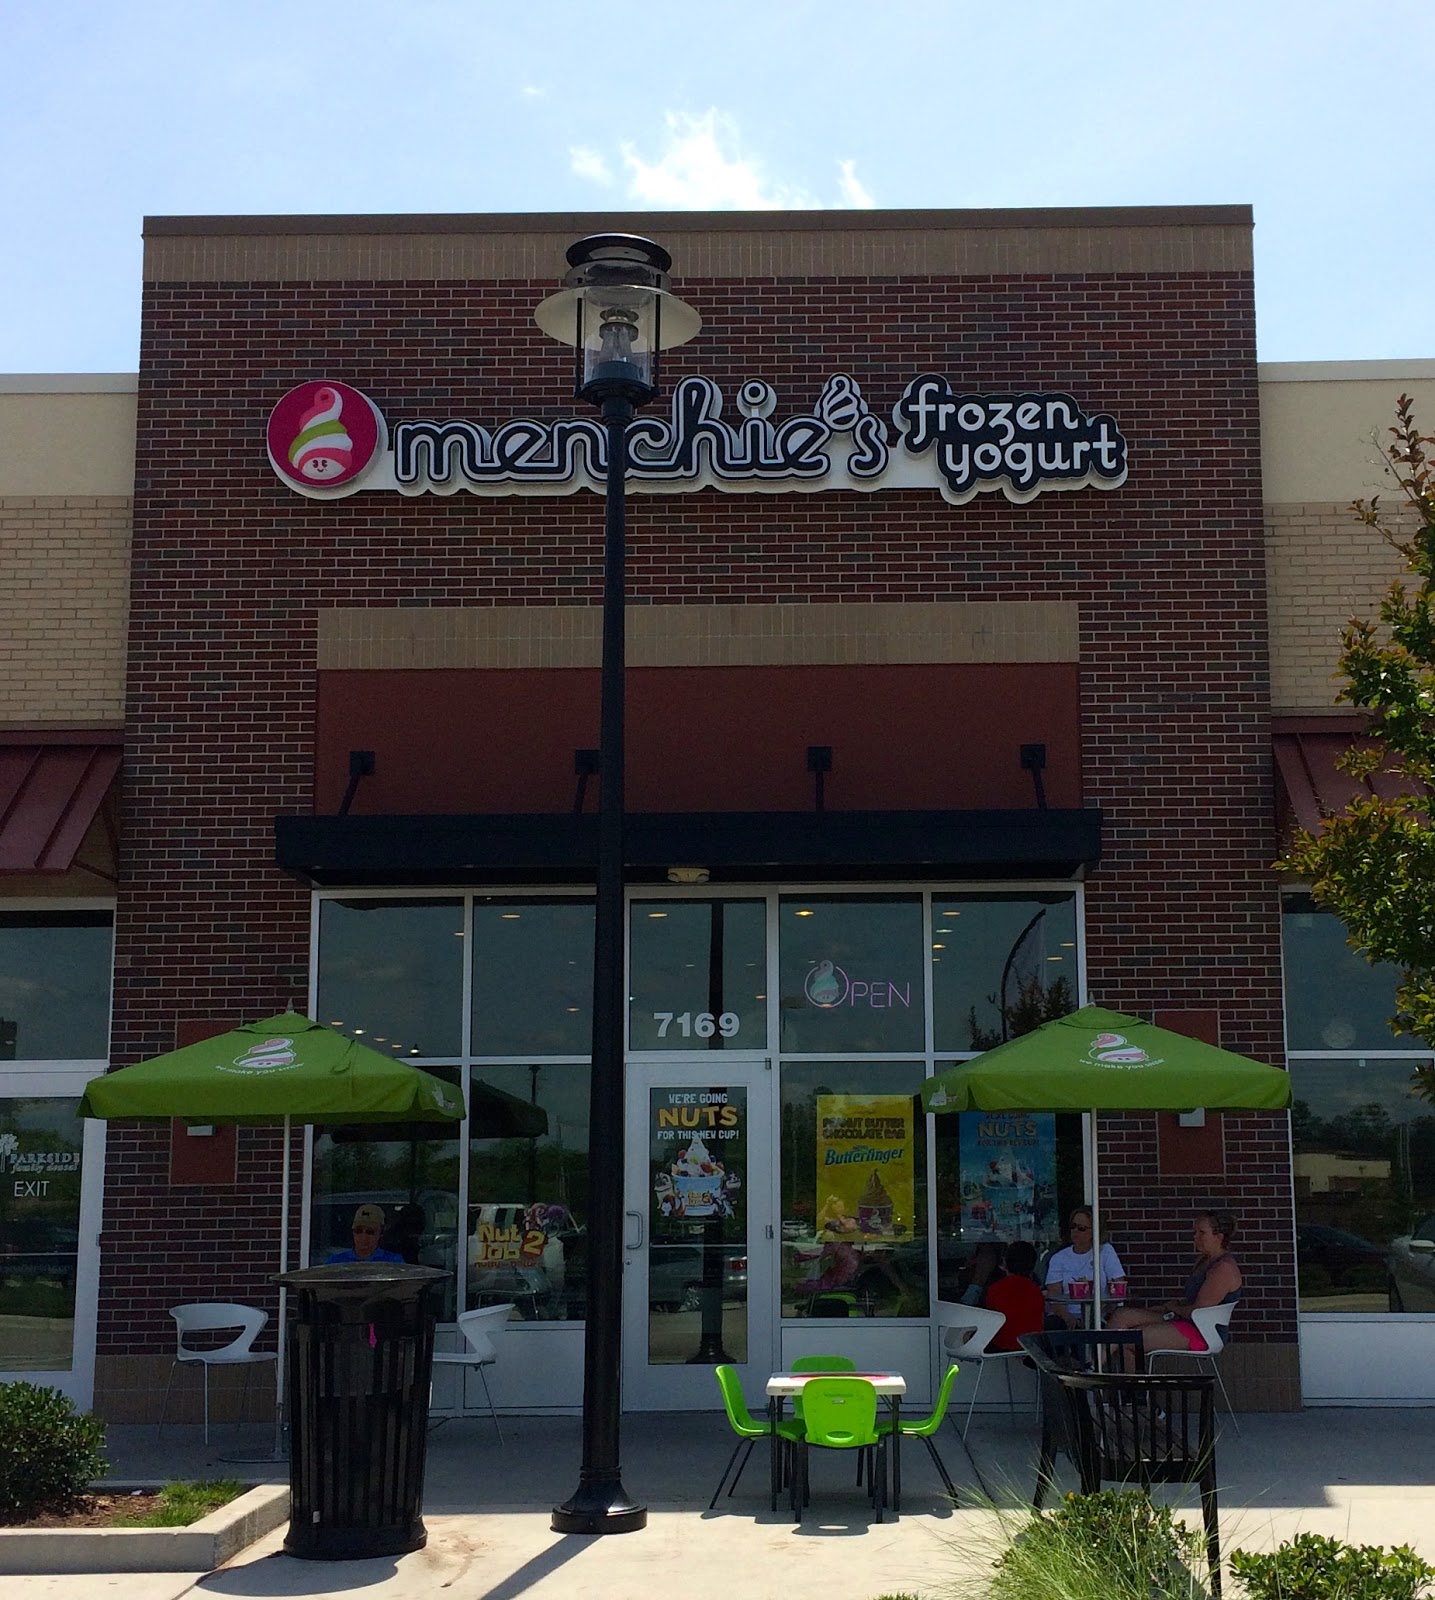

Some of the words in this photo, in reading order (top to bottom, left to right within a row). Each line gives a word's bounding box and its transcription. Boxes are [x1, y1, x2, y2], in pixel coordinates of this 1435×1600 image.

[908, 382, 1080, 445] frozen
[945, 423, 1117, 483] yogurt
[653, 1012, 740, 1037] 7169
[668, 1093, 697, 1104] WE'RE
[699, 1093, 728, 1104] GOING
[658, 1106, 739, 1128] NUTS
[657, 1130, 674, 1140] FOR
[678, 1130, 700, 1140] THIS
[701, 1130, 716, 1140] NEW
[718, 1130, 739, 1140] CUP!
[978, 1121, 1038, 1138] NUTS
[10, 1152, 80, 1163] PARKSIDE
[825, 1147, 904, 1165] Butterfinger
[14, 1180, 50, 1197] EXIT
[479, 1223, 520, 1243] Nut
[475, 1242, 520, 1260] Job
[523, 1229, 545, 1256] 2
